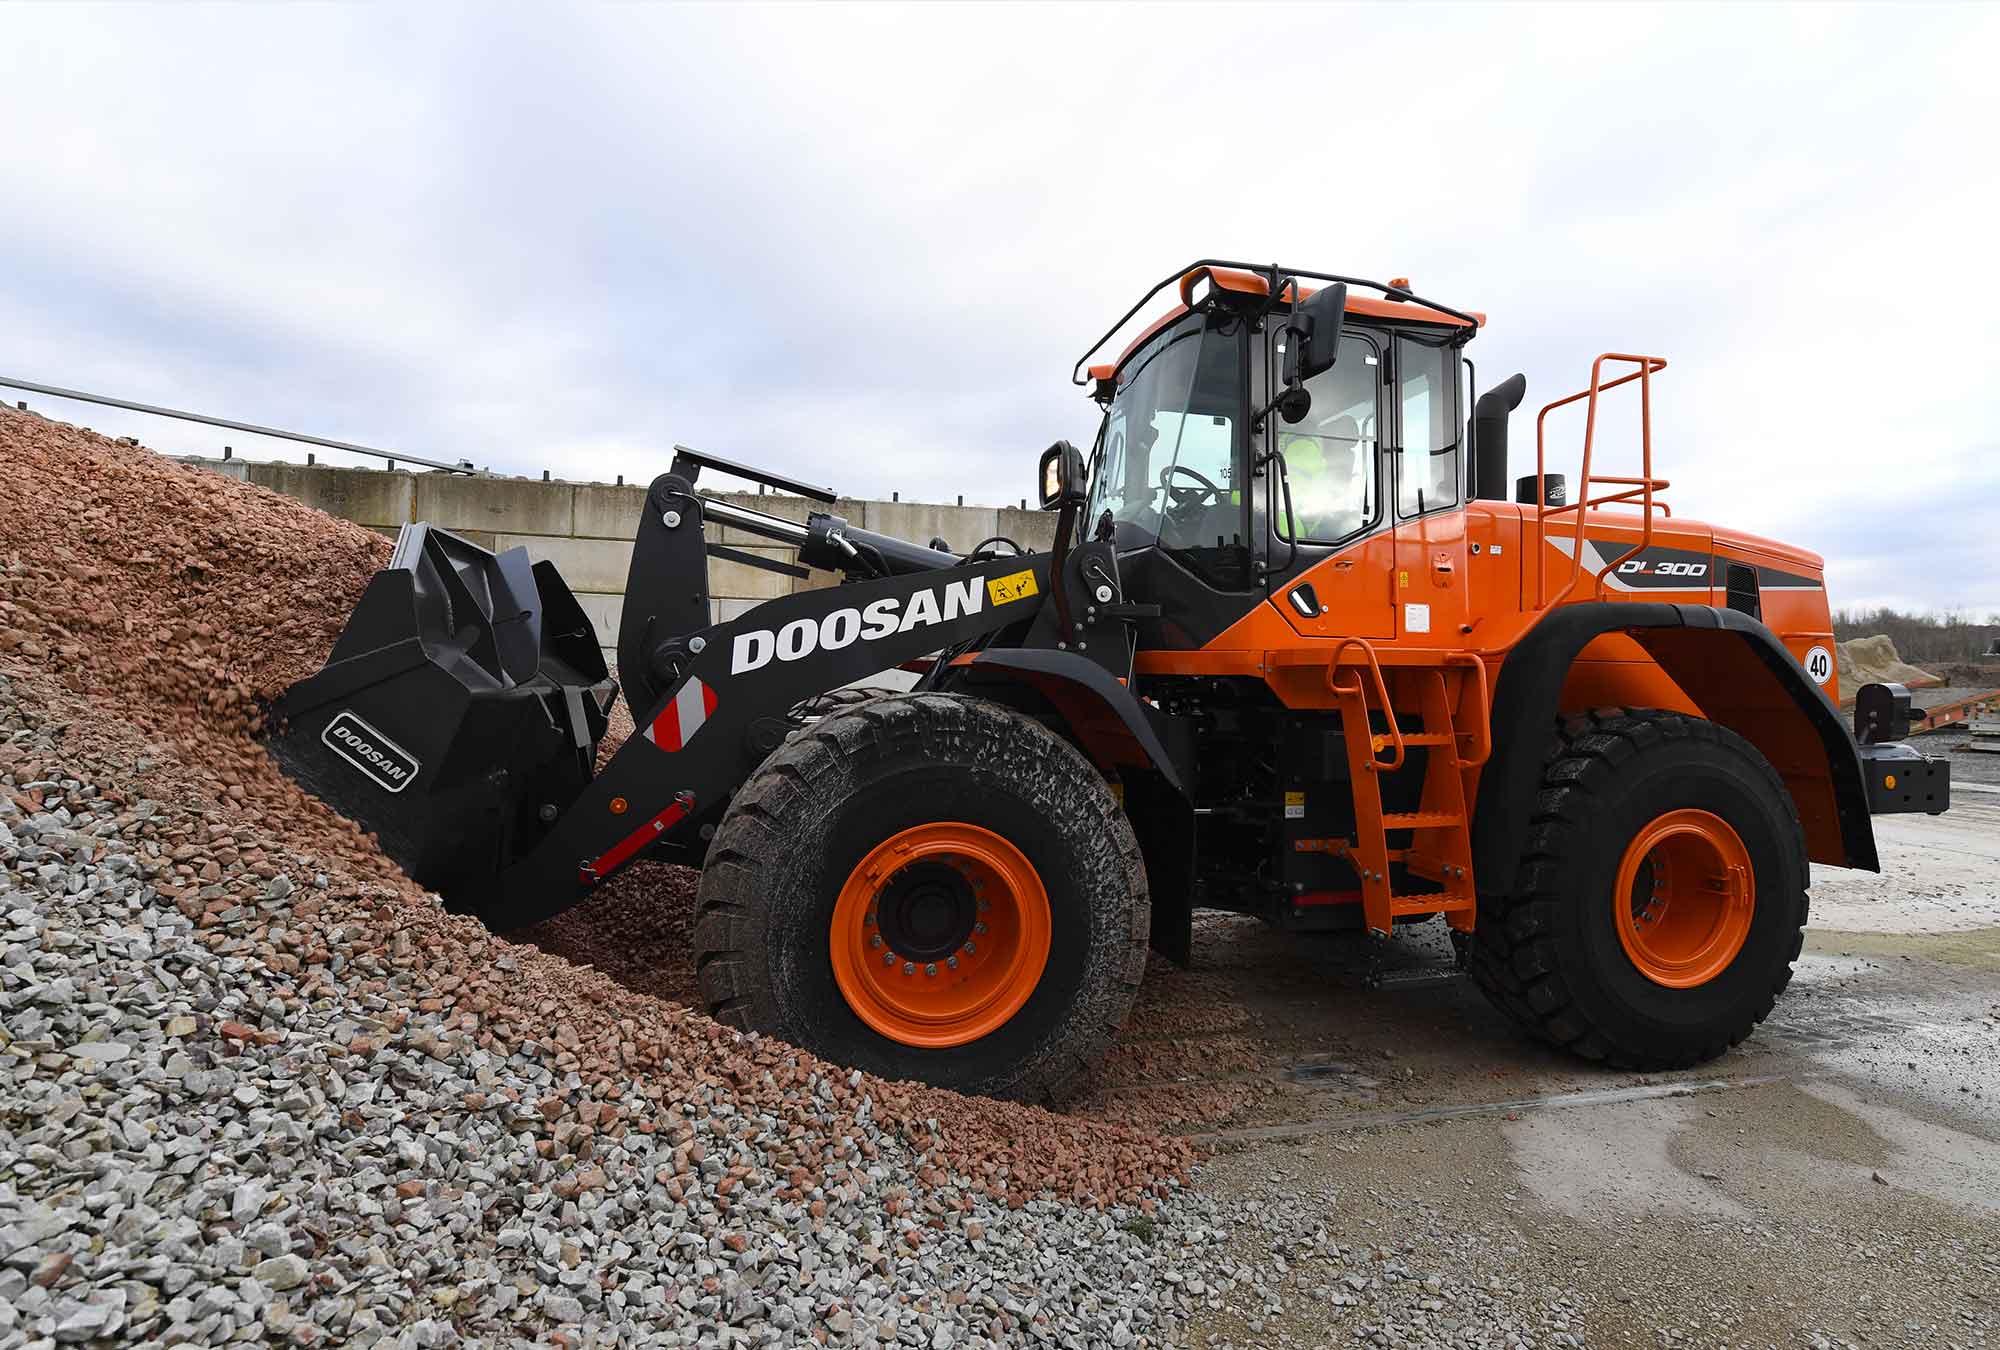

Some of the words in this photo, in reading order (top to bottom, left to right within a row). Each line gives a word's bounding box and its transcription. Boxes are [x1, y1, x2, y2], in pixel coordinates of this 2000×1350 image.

[1617, 560, 1707, 577] DL300
[731, 576, 985, 676] DOOSAN
[1810, 655, 1827, 677] 40
[333, 726, 407, 780] DOOSAN
